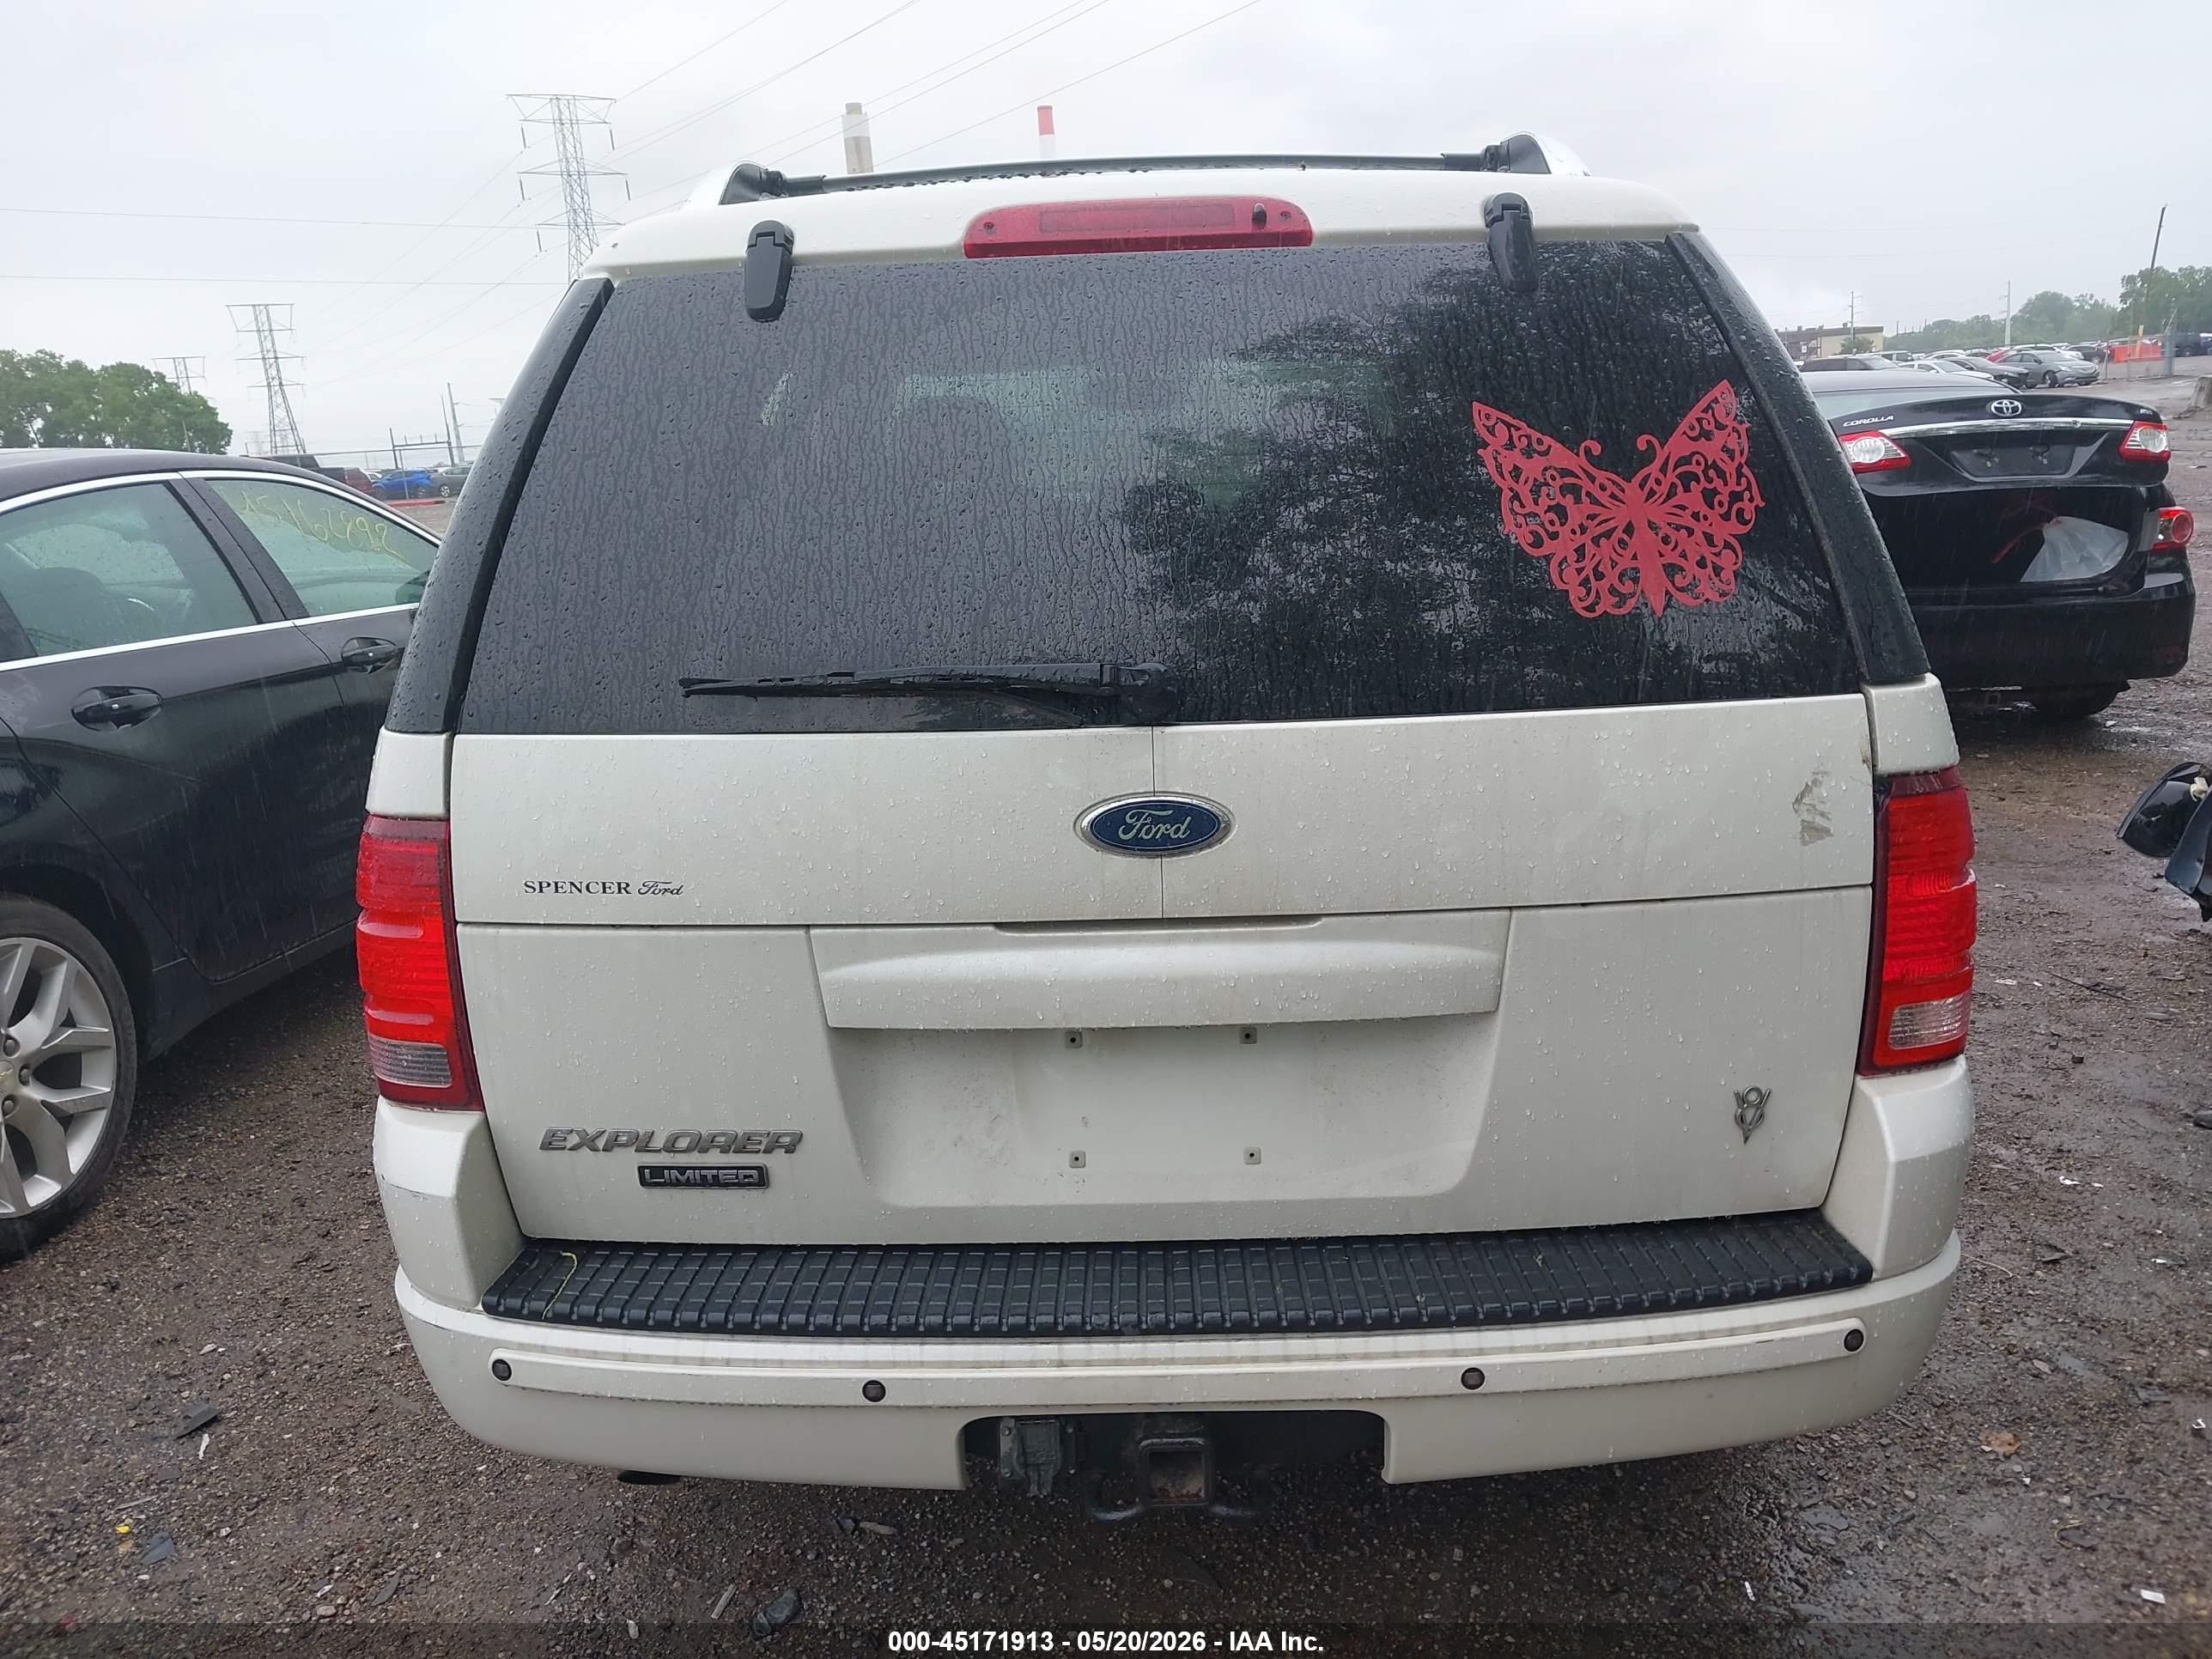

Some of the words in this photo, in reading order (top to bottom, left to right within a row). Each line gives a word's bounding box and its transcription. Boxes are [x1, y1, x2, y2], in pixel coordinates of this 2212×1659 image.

[1842, 415, 1894, 427] COROLLA
[1118, 809, 1191, 841] Ford
[524, 880, 632, 895] SPENCER
[637, 880, 684, 896] Ford
[538, 1127, 803, 1154] EXPLORER
[644, 1169, 760, 1184] LIMITED
